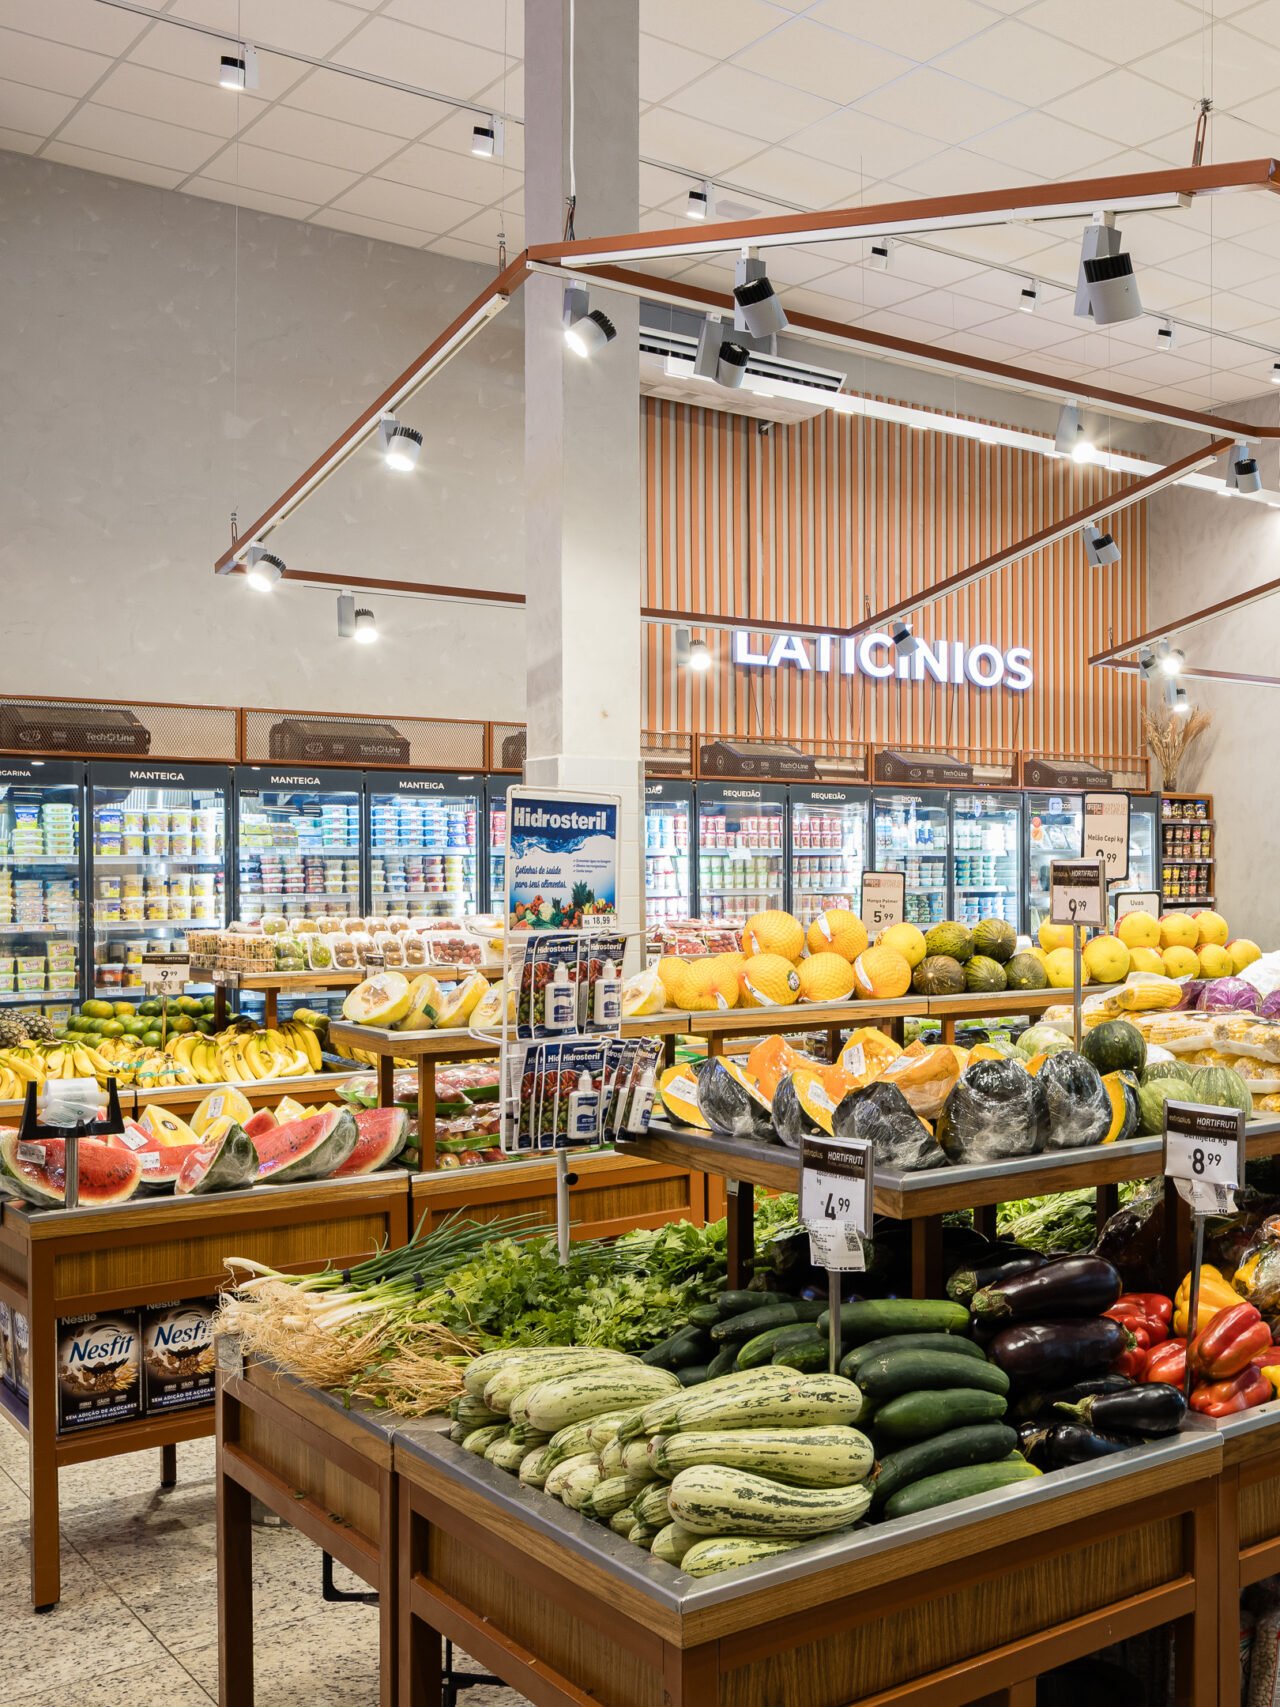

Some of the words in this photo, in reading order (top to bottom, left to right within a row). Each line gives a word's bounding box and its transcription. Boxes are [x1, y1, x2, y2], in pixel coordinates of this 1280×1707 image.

[129, 771, 185, 781] MANTEIGA
[271, 776, 321, 785] MANTEIGA
[399, 781, 445, 790] MANTEIGA
[513, 806, 607, 831] Hidrosteril
[537, 945, 574, 954] Hidrosteril
[590, 943, 622, 951] Hidrosteril
[563, 1053, 600, 1062] Hidrosteril
[1196, 1117, 1237, 1130] HORTIFRUTI
[827, 1151, 864, 1165] HORTIFRUTI
[69, 1335, 135, 1364] Nesfit
[164, 1392, 184, 1401] ADIÇÃO
[78, 1409, 100, 1418] ADIÇÃO
[109, 1403, 137, 1412] AÇÚCARES
